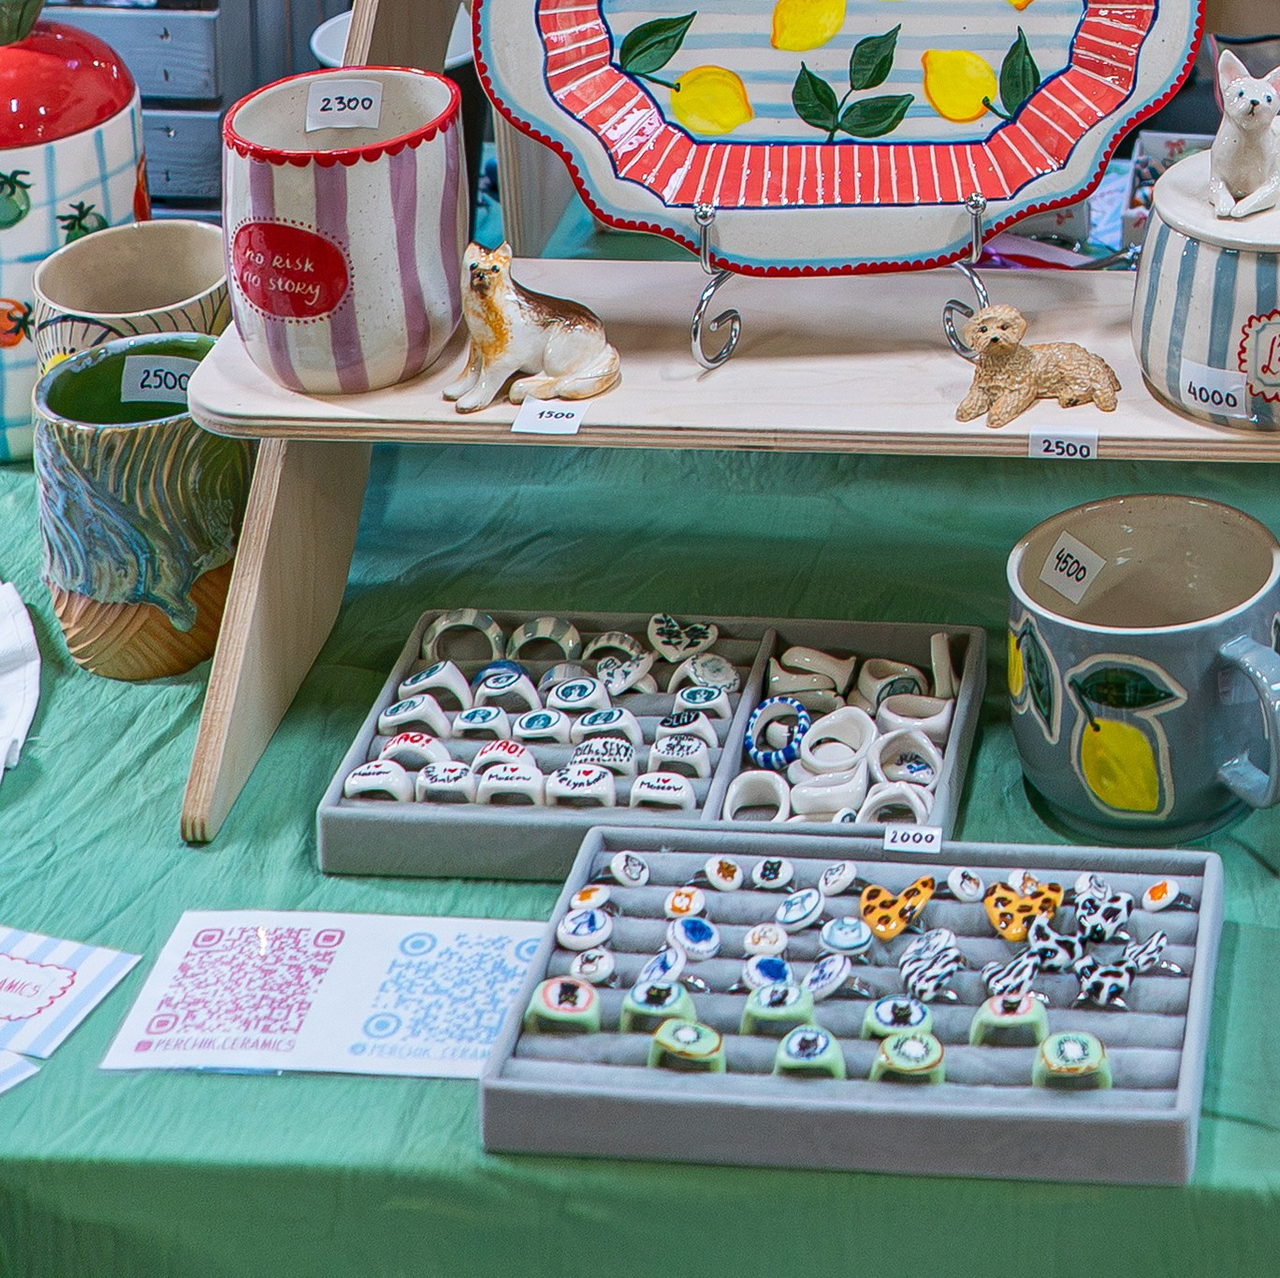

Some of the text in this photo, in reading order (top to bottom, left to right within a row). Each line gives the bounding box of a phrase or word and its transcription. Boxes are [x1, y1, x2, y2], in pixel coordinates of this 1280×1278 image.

[319, 95, 373, 112] 2300
[140, 369, 190, 392] 2500
[1187, 381, 1238, 407] 4000
[537, 410, 575, 420] 1500
[1042, 439, 1091, 458] 2500
[1053, 547, 1087, 583] 4500
[890, 830, 935, 844] 2000
[153, 1037, 297, 1052] PERCHIK.CERAMICS
